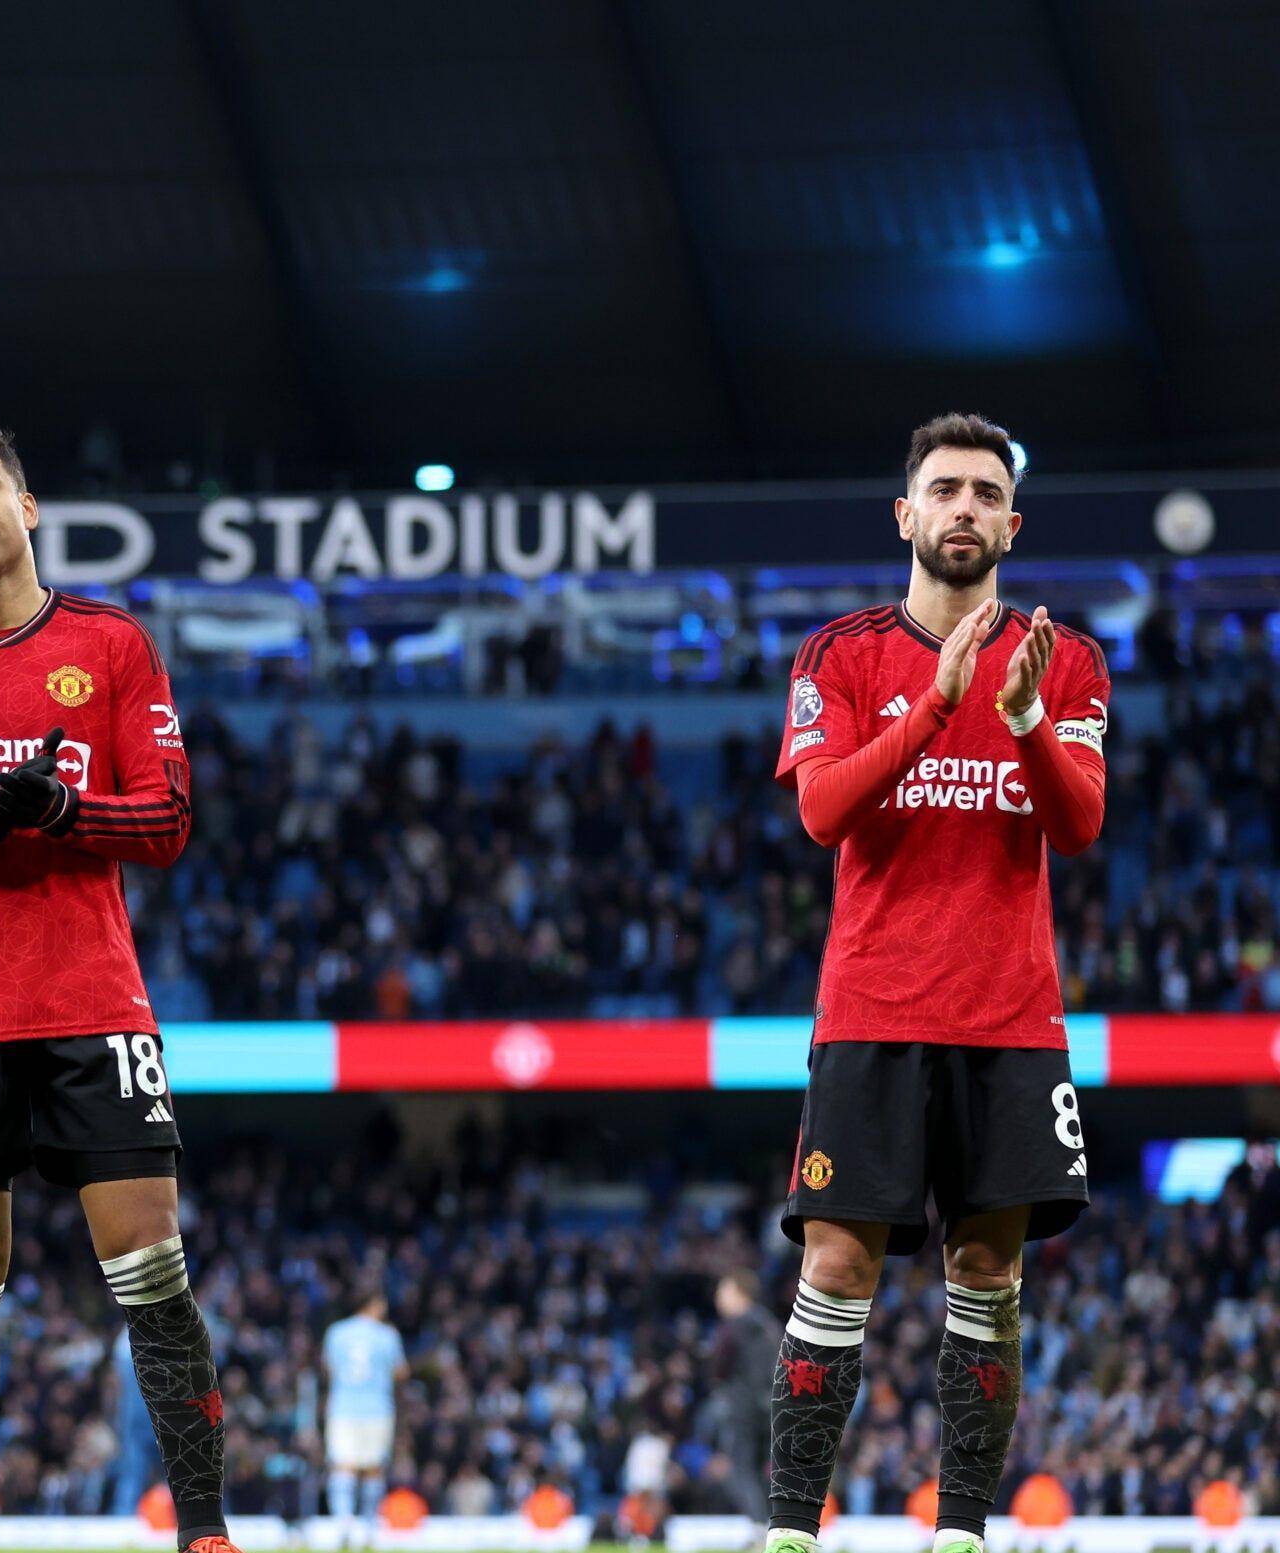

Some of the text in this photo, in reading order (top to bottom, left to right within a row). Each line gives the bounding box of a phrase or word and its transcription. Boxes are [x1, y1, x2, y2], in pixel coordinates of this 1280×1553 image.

[198, 493, 655, 586] STADIUM
[879, 780, 992, 811] iewer
[907, 752, 993, 783] eam
[106, 1034, 166, 1098] 18
[1052, 1082, 1085, 1149] 8
